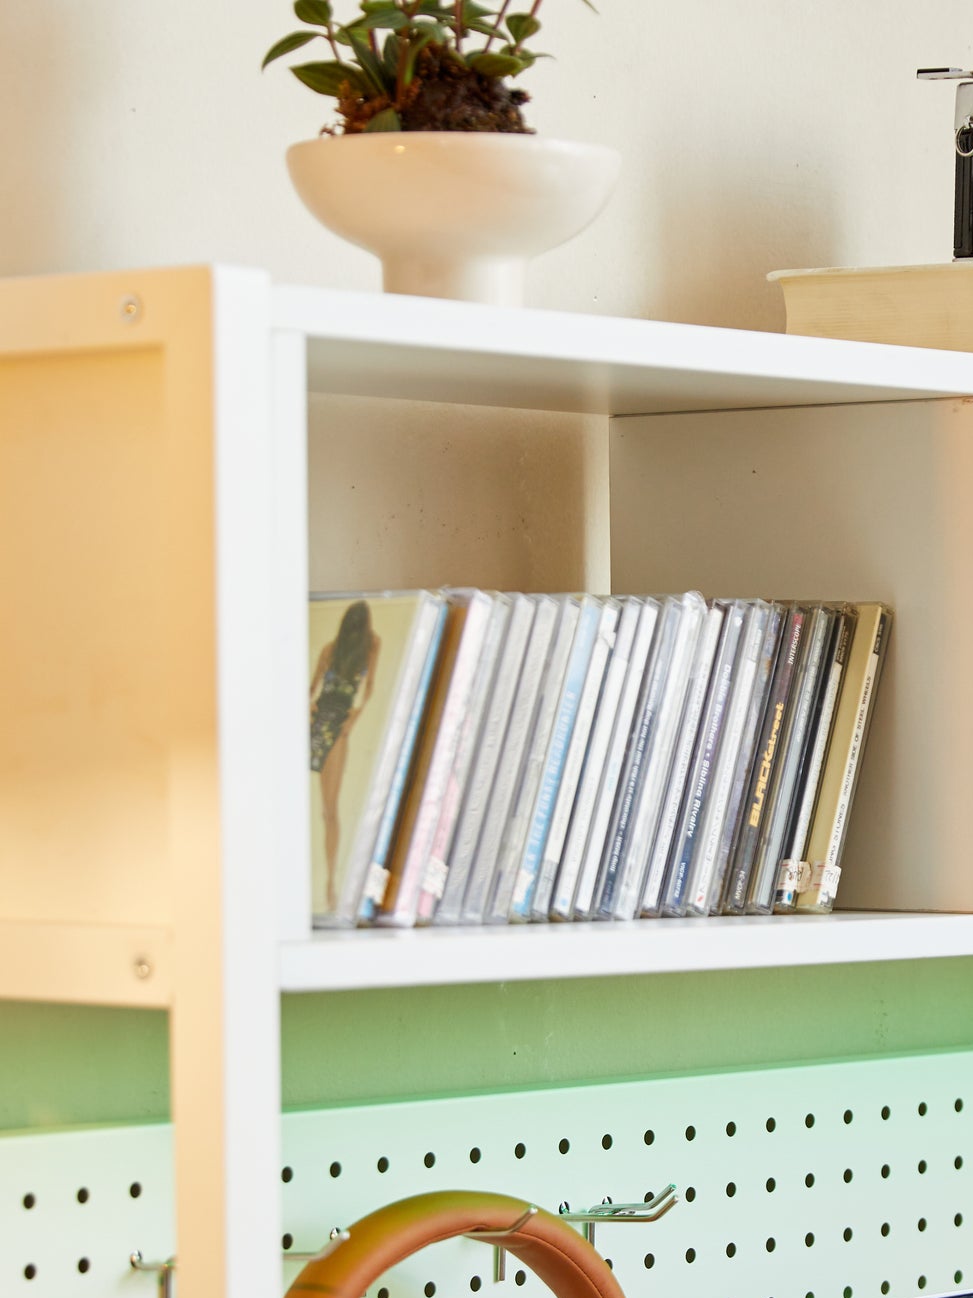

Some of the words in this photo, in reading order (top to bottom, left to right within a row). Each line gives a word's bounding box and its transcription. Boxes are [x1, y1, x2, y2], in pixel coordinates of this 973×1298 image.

[787, 623, 802, 666] INTERSCOPE
[857, 704, 865, 730] STEEL
[861, 676, 872, 704] WHEELS
[707, 702, 726, 750] Brothers
[695, 758, 710, 797] Sibling
[687, 799, 702, 838] Rivalry
